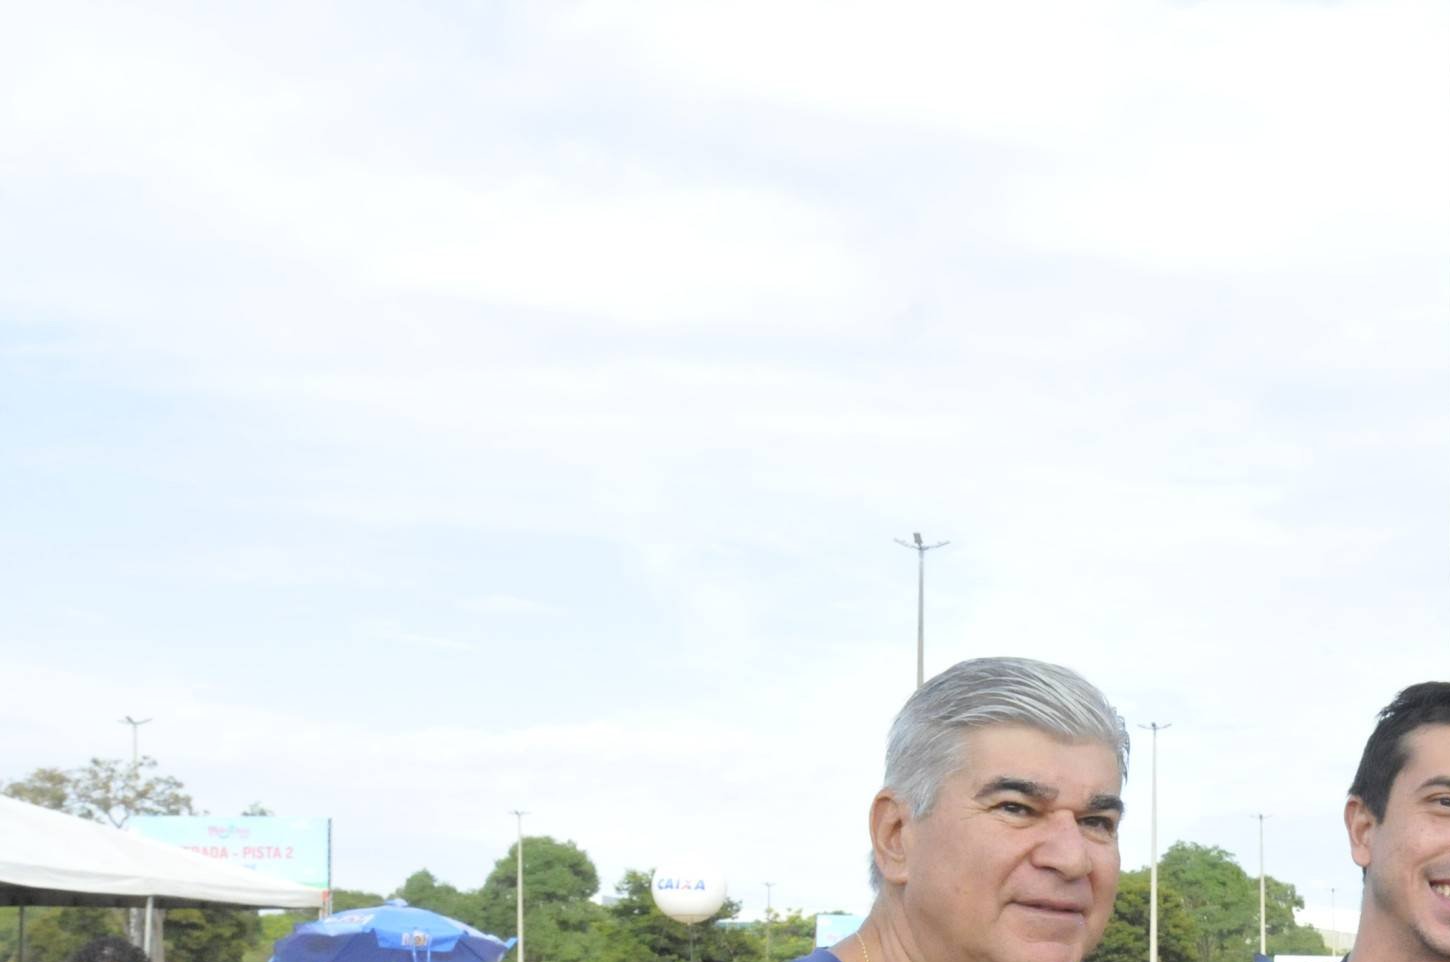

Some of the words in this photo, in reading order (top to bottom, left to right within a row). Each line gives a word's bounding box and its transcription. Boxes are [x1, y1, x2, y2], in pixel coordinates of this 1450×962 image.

[243, 846, 281, 859] PISTA
[285, 846, 294, 859] 2
[657, 878, 705, 890] CAIXA
